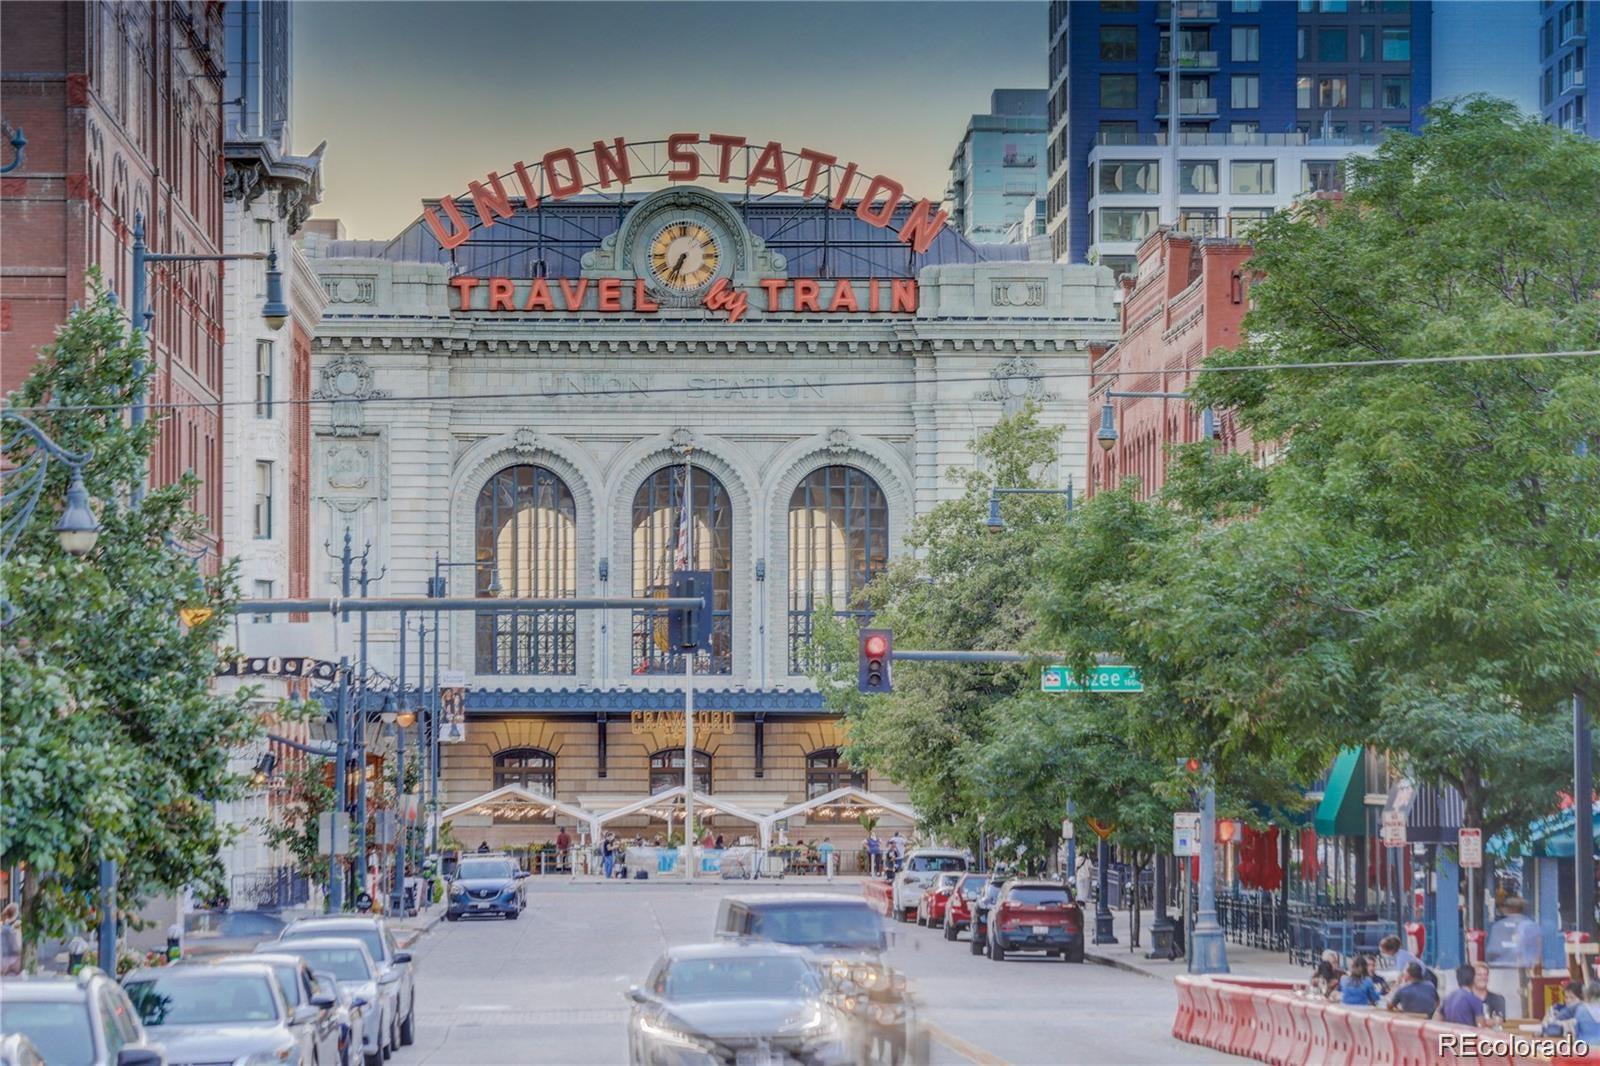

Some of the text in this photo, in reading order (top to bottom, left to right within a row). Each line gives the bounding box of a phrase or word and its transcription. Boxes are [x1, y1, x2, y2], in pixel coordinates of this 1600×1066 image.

[424, 137, 632, 249] UNION
[668, 133, 948, 254] STATION
[450, 277, 916, 322] TRAVEL by TRAIN
[539, 377, 827, 399] UNION STATION
